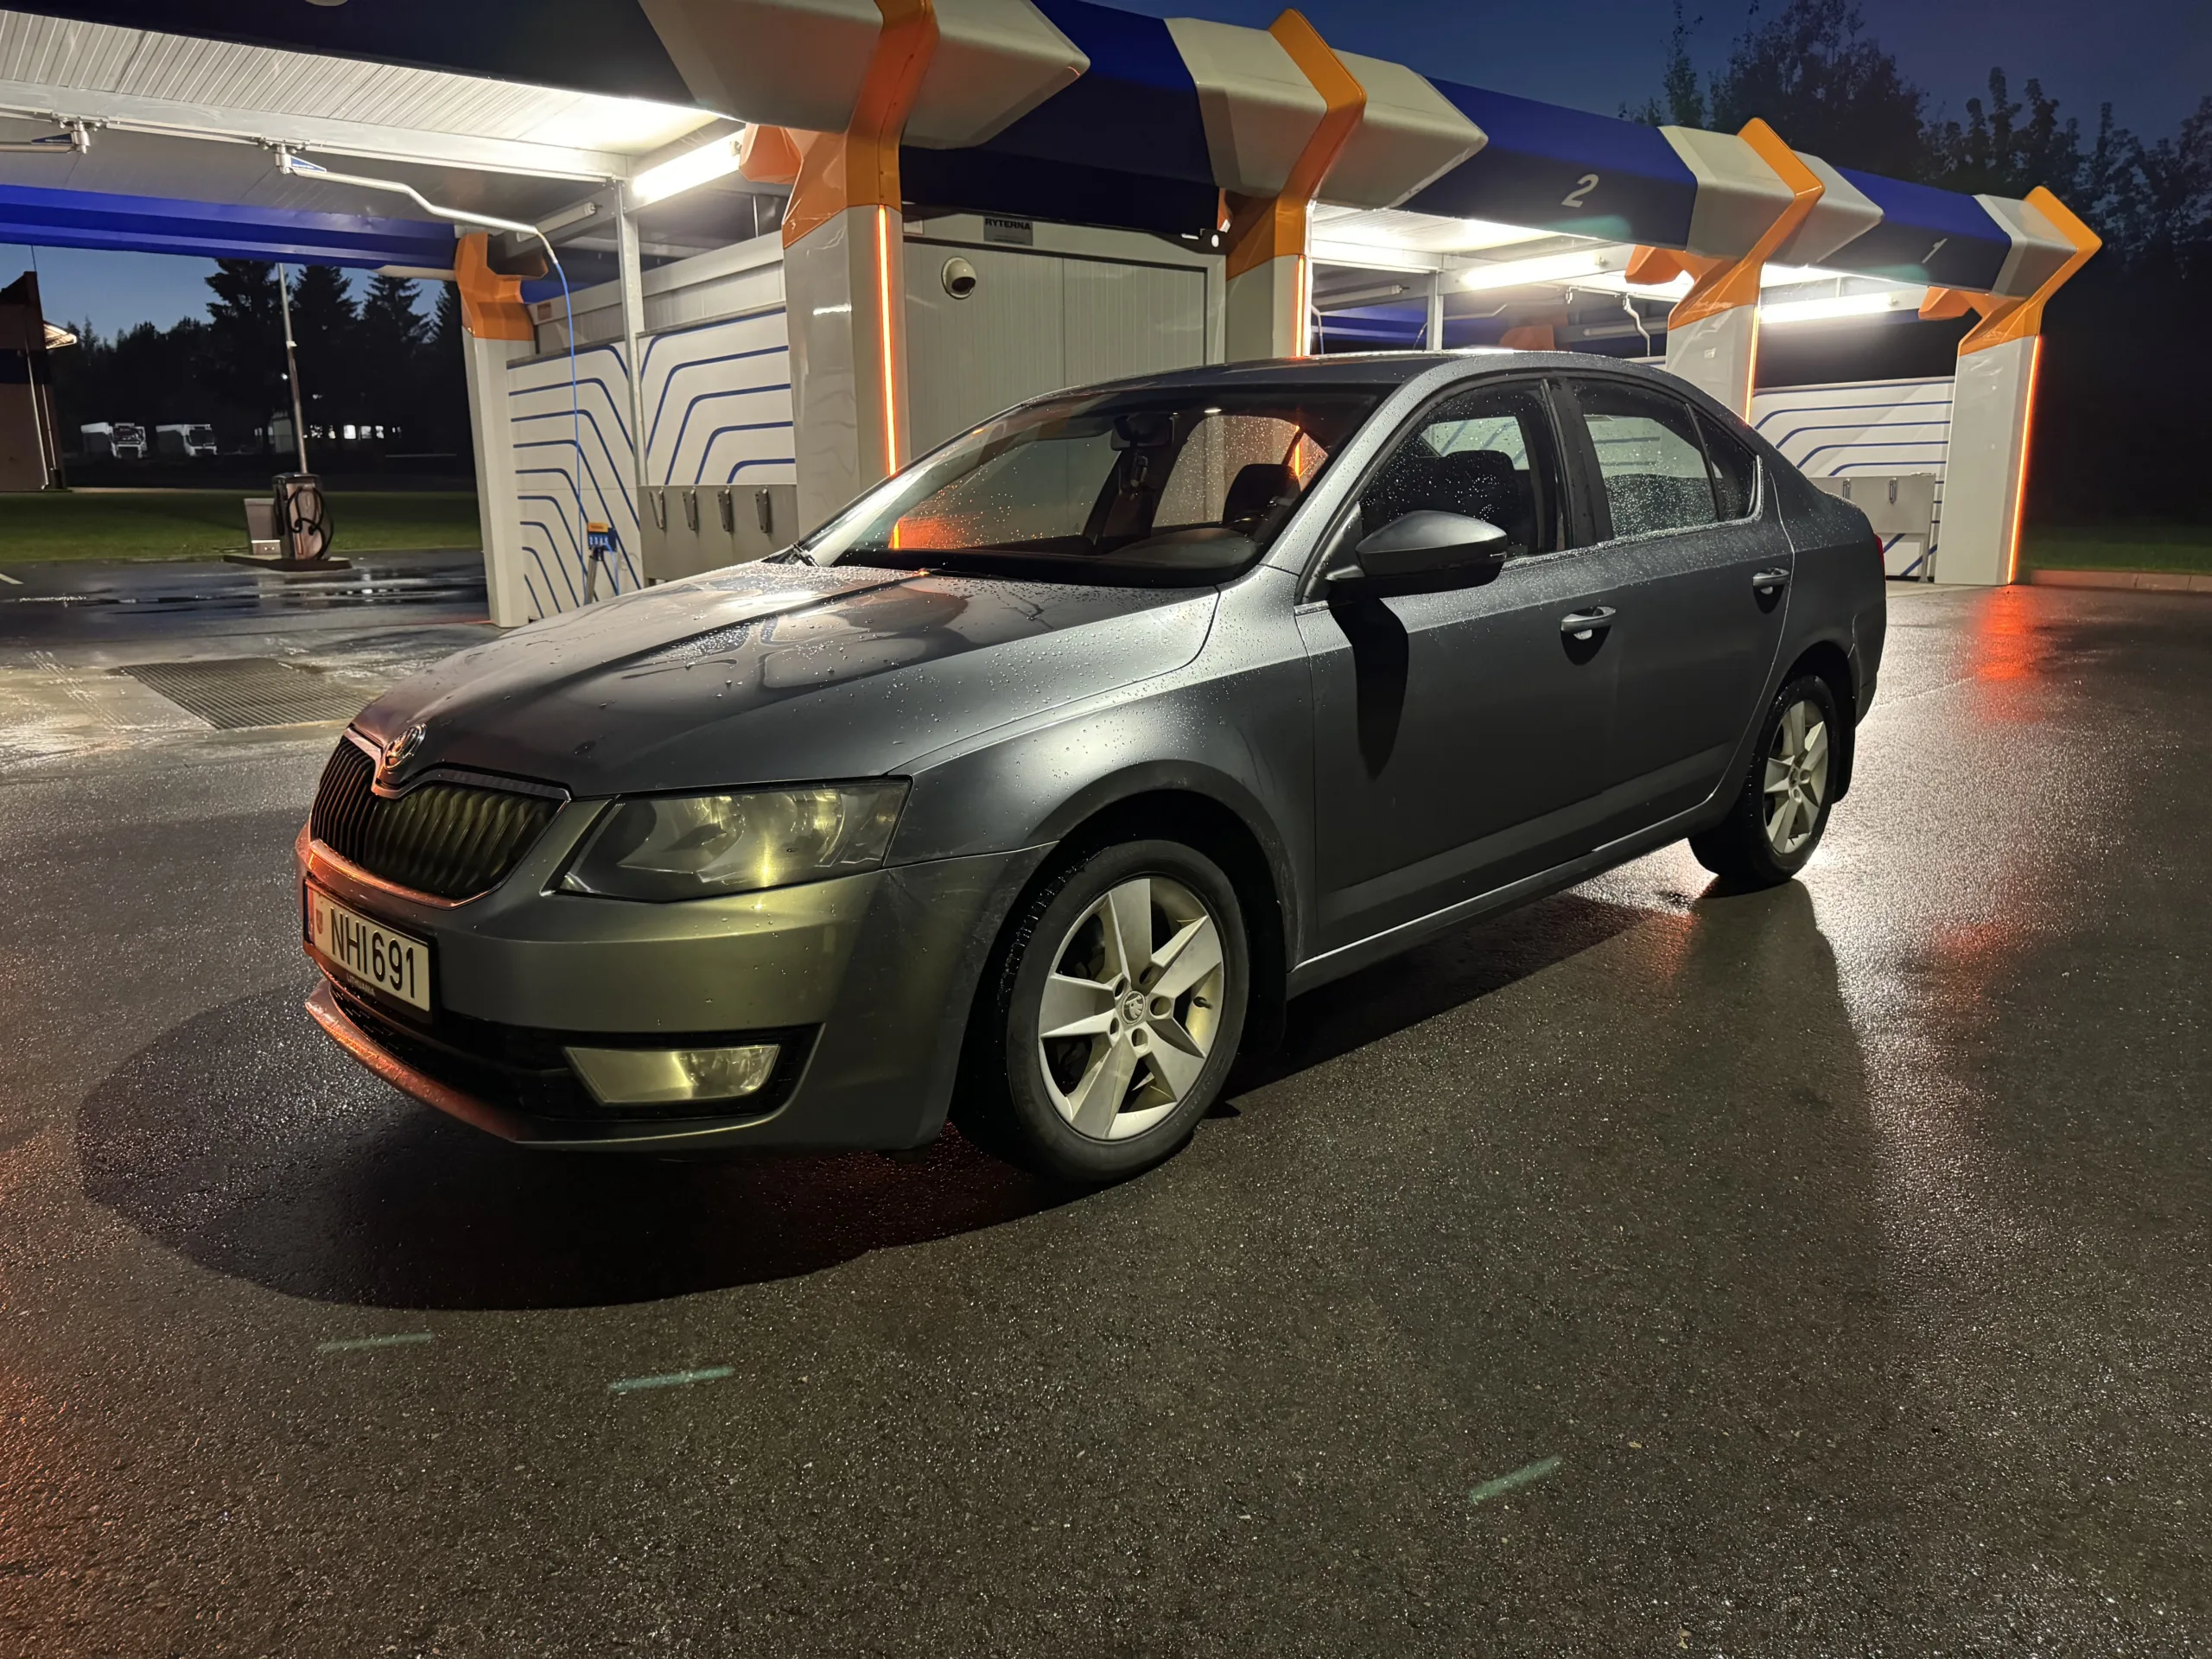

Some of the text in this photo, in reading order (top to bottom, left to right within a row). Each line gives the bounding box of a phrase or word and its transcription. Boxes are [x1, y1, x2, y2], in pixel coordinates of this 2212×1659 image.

[1560, 174, 1599, 208] 2
[985, 218, 1031, 230] RYTERNA
[1922, 238, 1948, 264] 1
